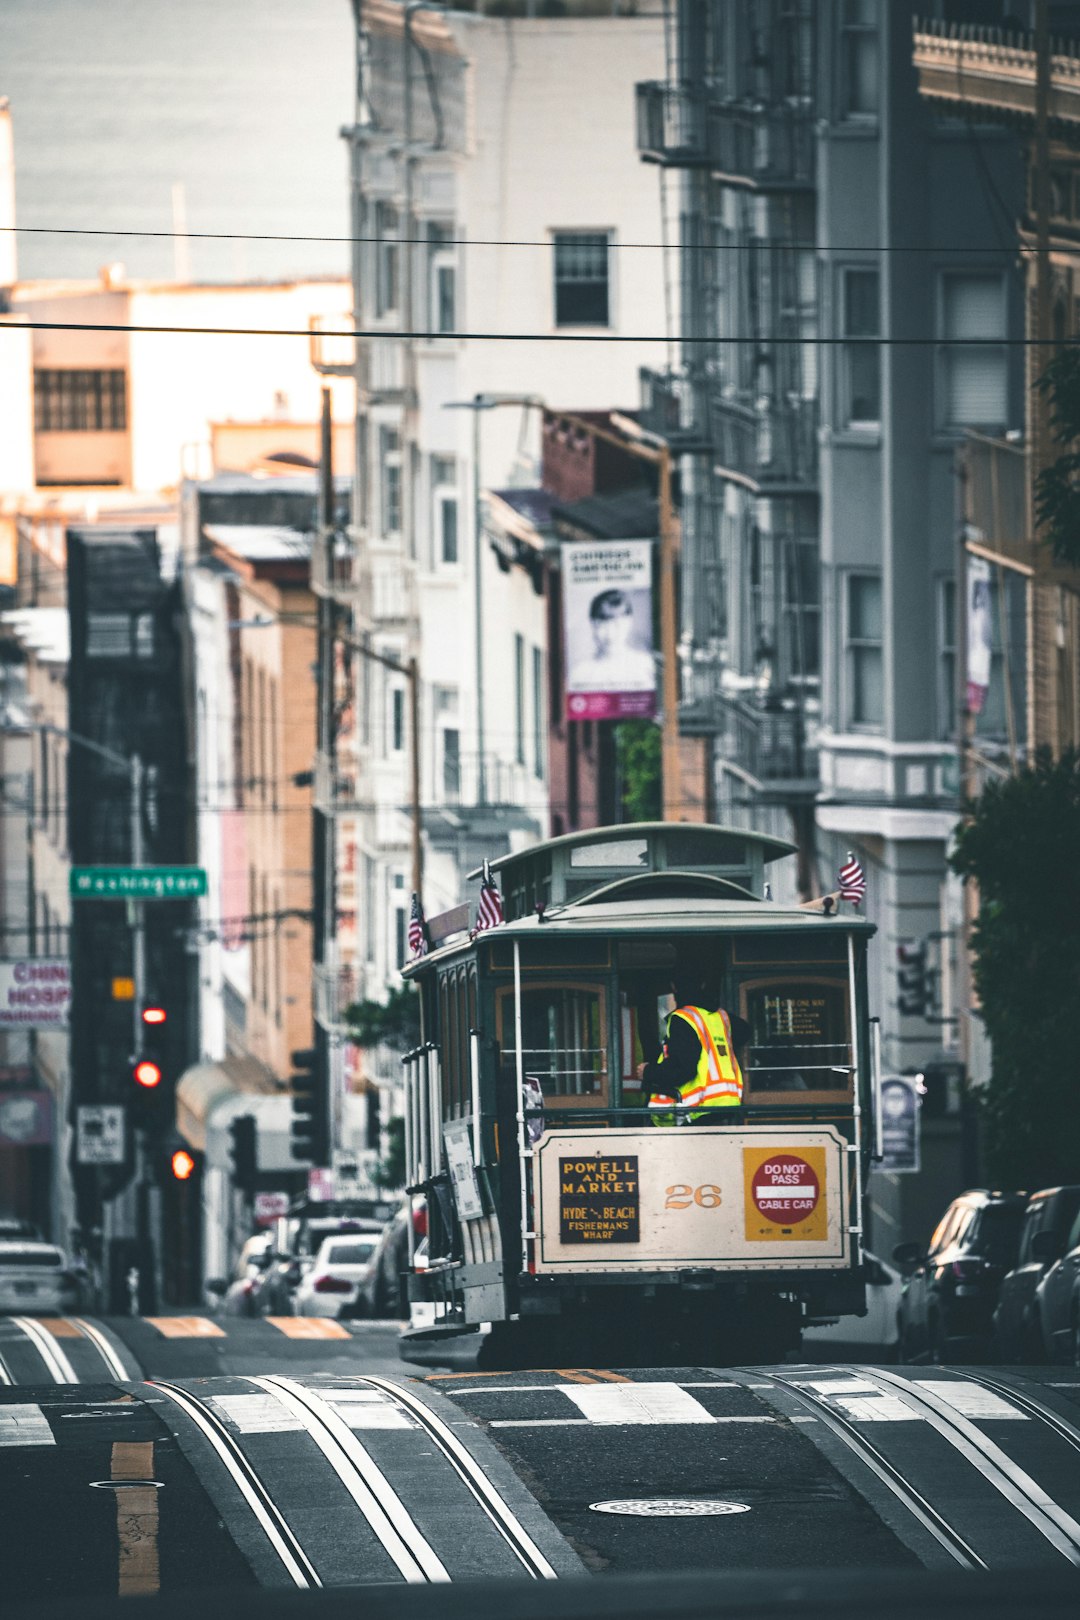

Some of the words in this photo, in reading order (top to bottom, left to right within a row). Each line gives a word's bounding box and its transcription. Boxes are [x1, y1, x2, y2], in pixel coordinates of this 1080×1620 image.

[78, 875, 199, 896] Washington
[563, 1162, 635, 1174] POWELL
[764, 1164, 782, 1175] DO
[783, 1164, 806, 1174] NOT
[582, 1173, 618, 1182] AND
[771, 1174, 800, 1184] PASS
[562, 1182, 636, 1193] MARKET
[665, 1184, 722, 1209] 26
[758, 1200, 790, 1209] CABLE
[792, 1200, 814, 1209] CAR
[563, 1207, 588, 1219] HYDE
[603, 1207, 635, 1219] BEACH
[568, 1221, 629, 1230] FISHERMANS
[583, 1230, 614, 1239] WHARF
